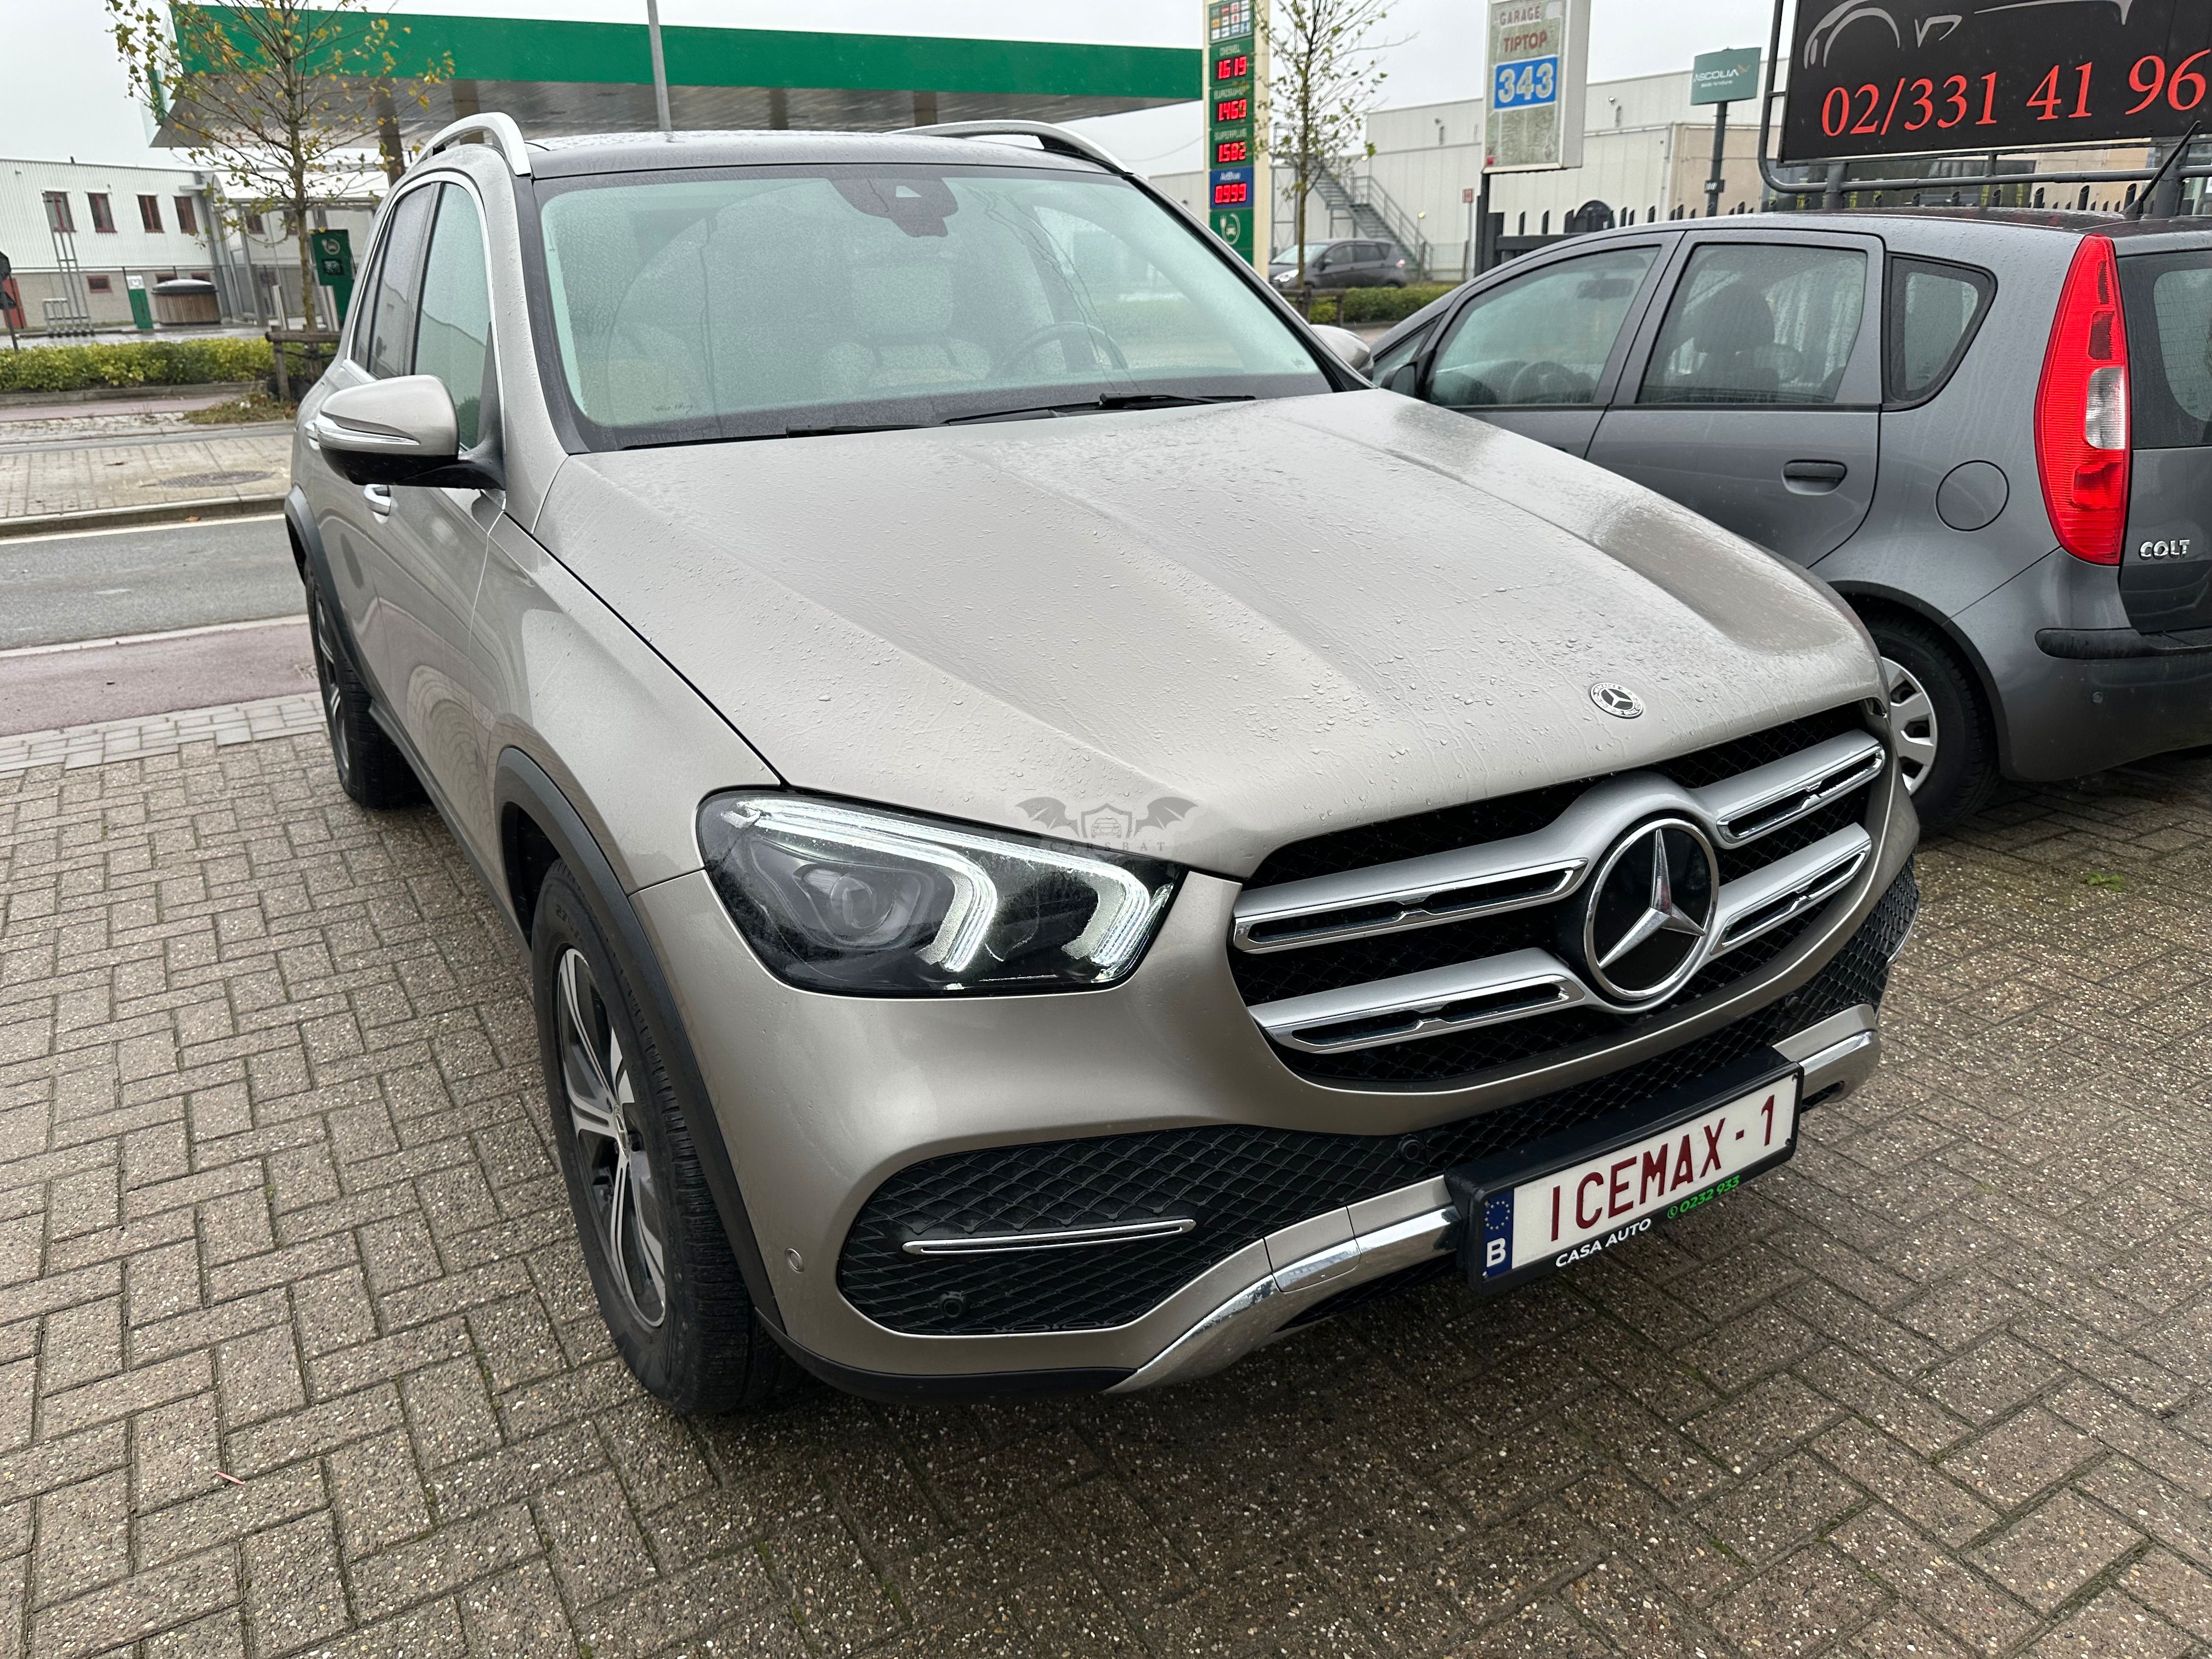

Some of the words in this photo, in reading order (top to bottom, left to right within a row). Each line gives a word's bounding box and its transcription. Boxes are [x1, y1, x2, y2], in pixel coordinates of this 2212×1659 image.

[1499, 5, 1541, 26] GARAGE
[1504, 29, 1547, 53] TIPTOP
[1498, 63, 1554, 103] 343
[1821, 71, 1997, 137] 02/331
[2026, 61, 2093, 121] 41
[2125, 49, 2211, 115] 96
[2140, 539, 2190, 558] COLT
[1555, 1240, 1602, 1267] CASA
[1605, 1218, 1652, 1248] AUTO
[1679, 1188, 1714, 1214] 0232
[1716, 1175, 1740, 1194] 933
[1486, 1238, 1506, 1268] B
